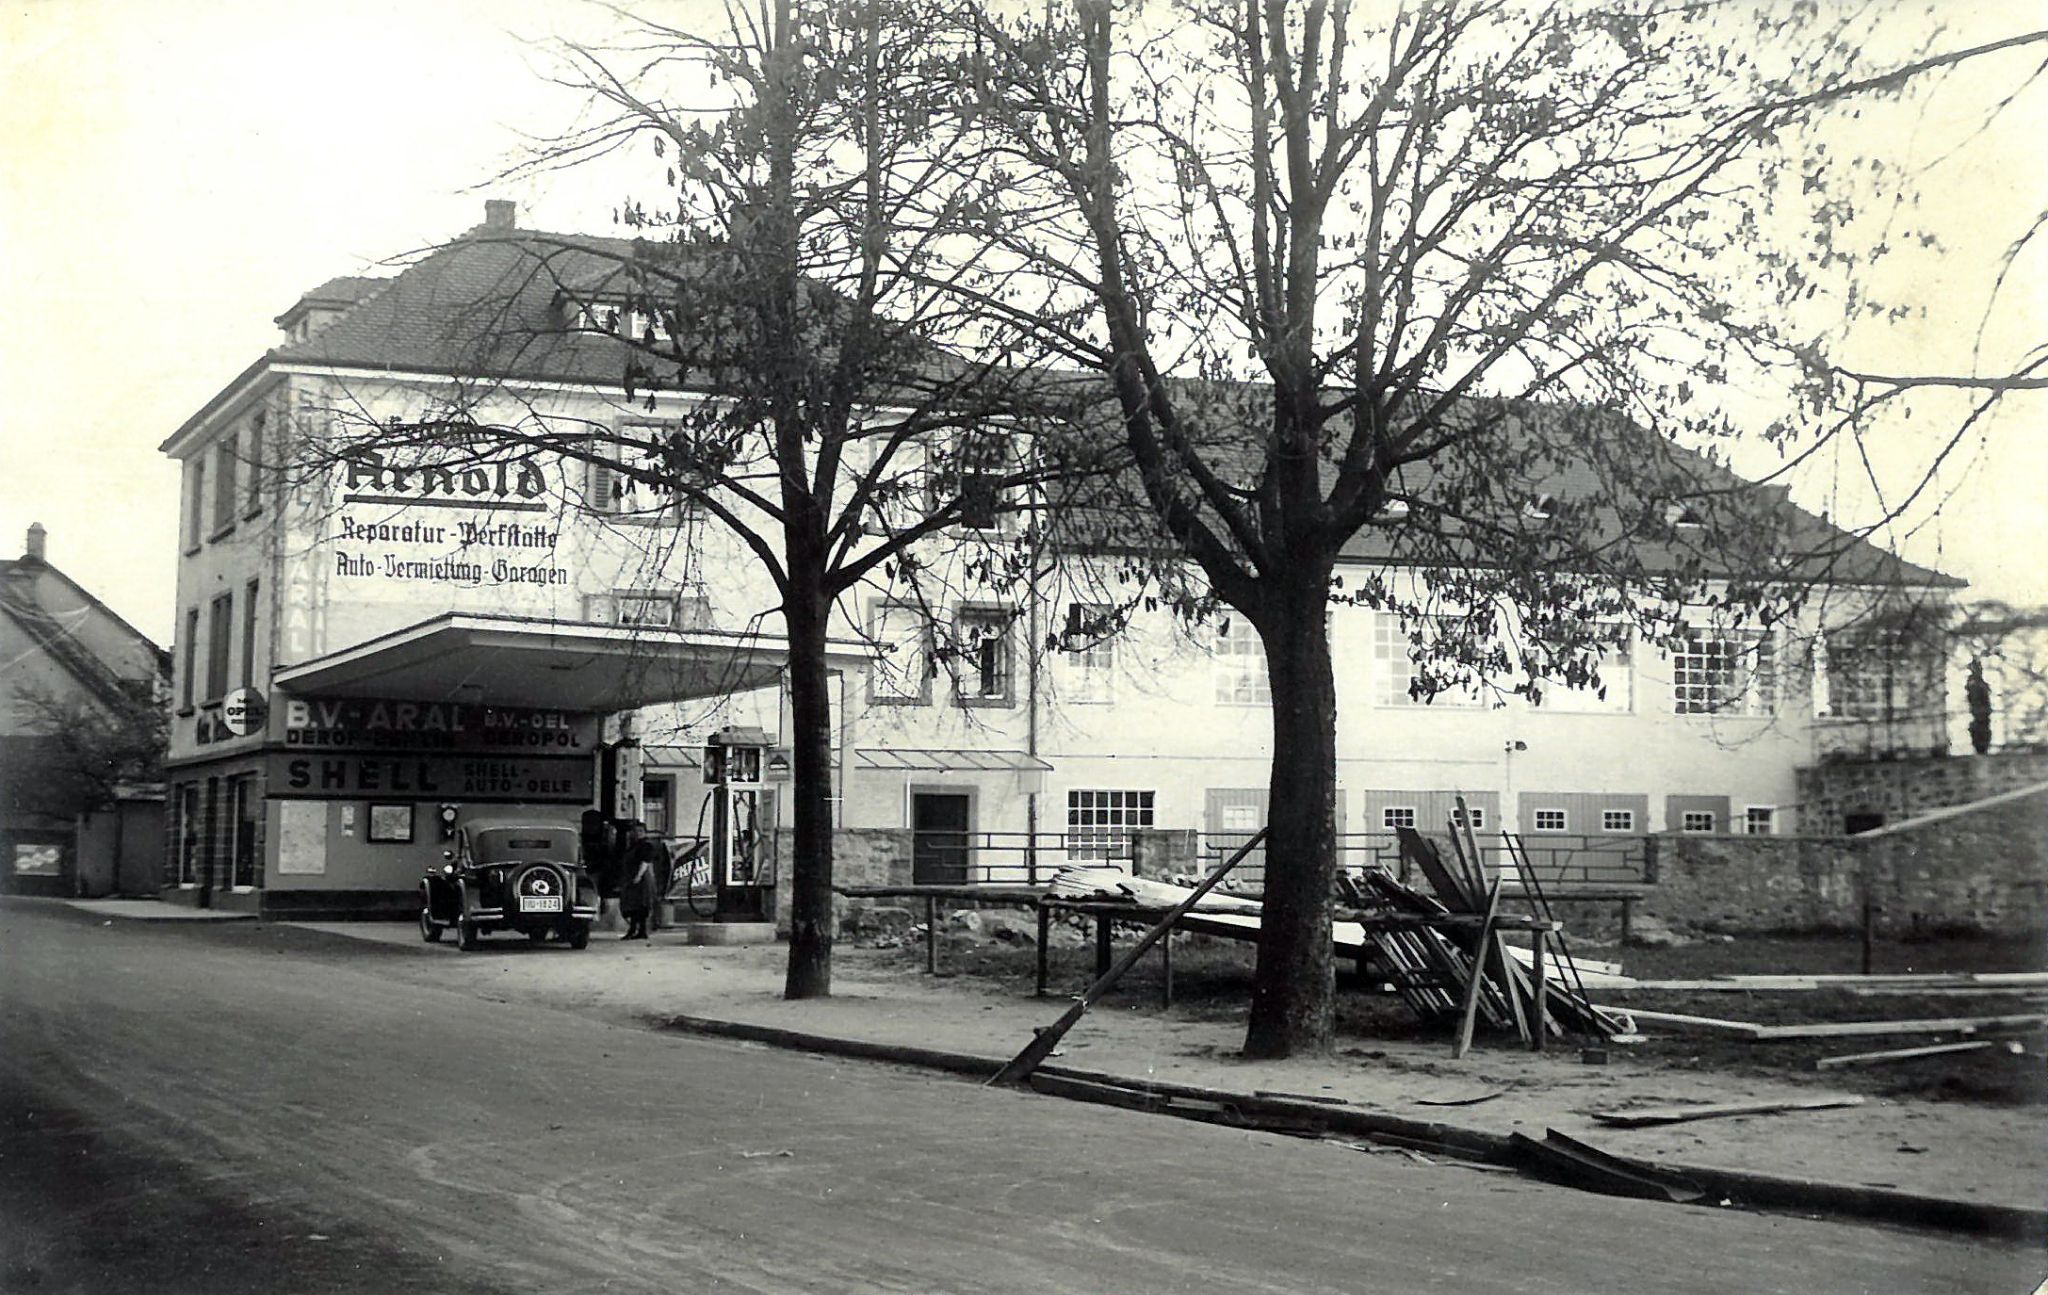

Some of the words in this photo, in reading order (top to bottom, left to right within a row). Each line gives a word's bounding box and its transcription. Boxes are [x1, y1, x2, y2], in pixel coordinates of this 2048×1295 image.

[345, 446, 547, 499] Arnold
[287, 700, 464, 731] B.V.-ARAL
[485, 731, 580, 748] DEROPOL
[289, 759, 437, 791] SHELL
[465, 778, 571, 793] AUTO-OELE
